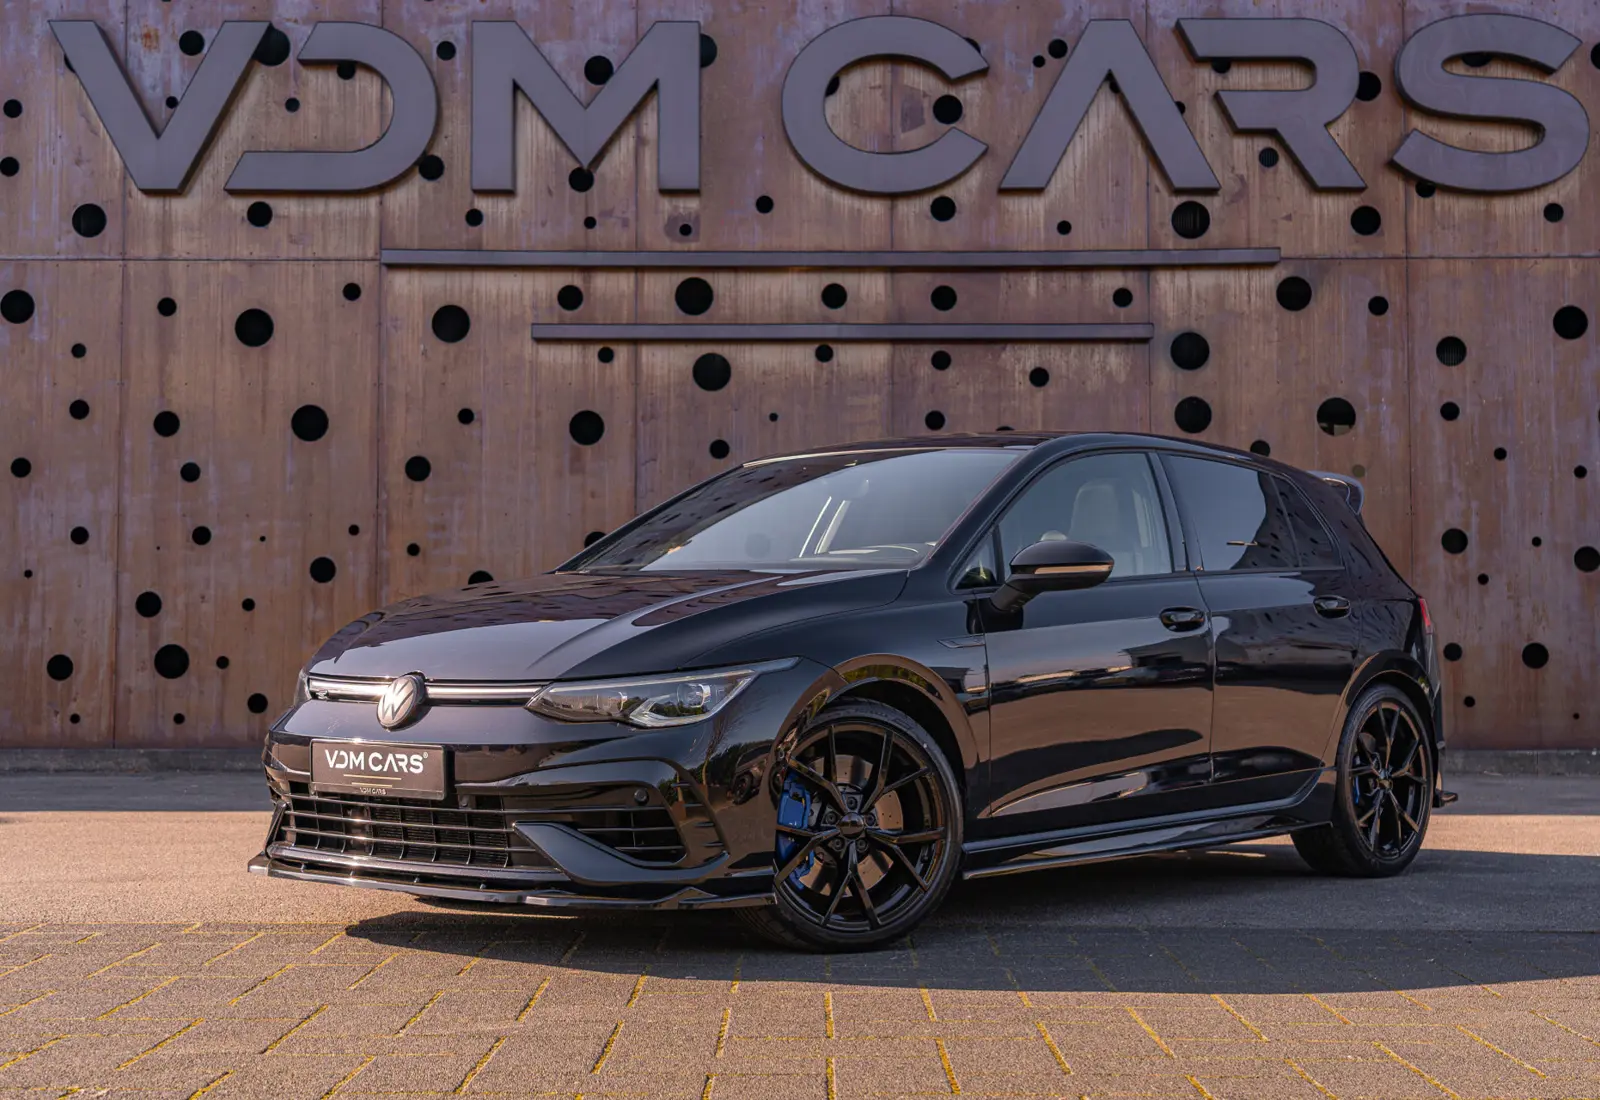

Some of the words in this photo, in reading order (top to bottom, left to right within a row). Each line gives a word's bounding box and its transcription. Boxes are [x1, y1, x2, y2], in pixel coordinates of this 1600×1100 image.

[48, 20, 702, 194] VDM
[780, 13, 1592, 194] CARS
[324, 749, 366, 771] VDM
